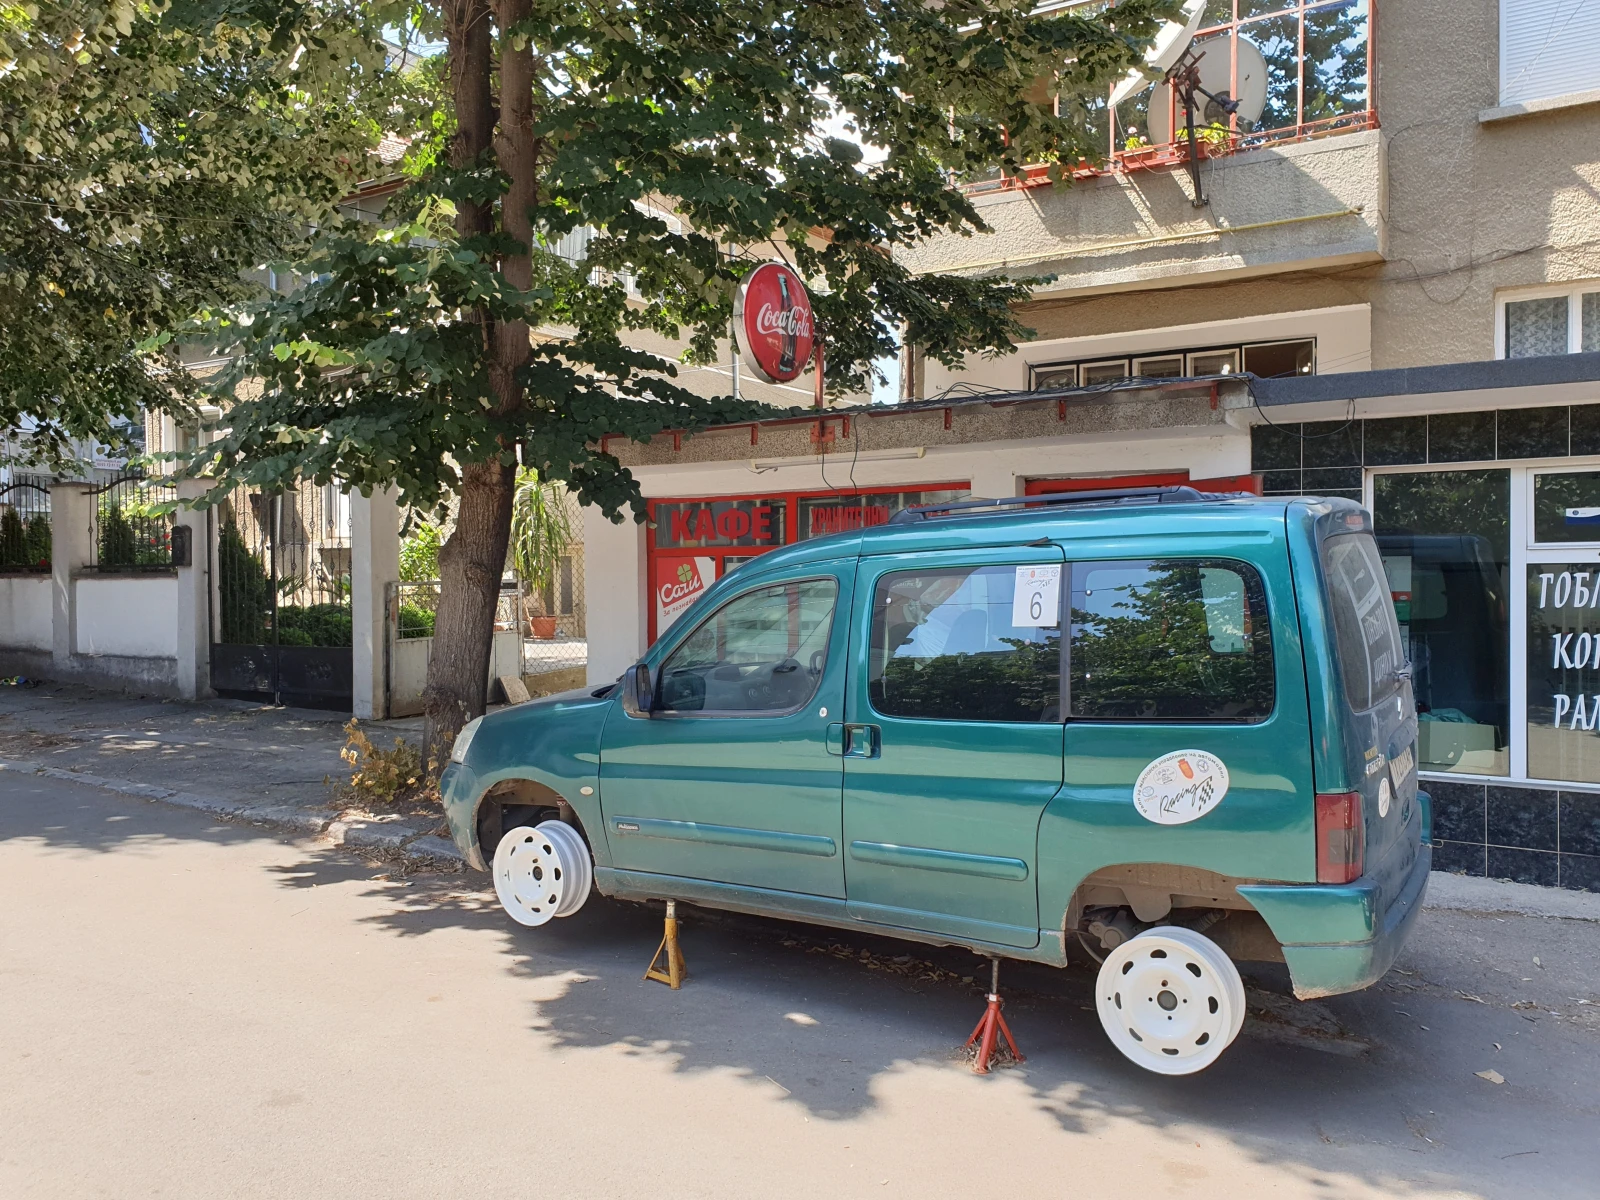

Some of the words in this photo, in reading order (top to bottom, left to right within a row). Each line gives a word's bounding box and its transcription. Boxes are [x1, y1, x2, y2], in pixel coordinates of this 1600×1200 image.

[756, 302, 811, 338] Coca-Cola
[671, 506, 772, 542] КАФЕ
[1030, 591, 1043, 621] 6
